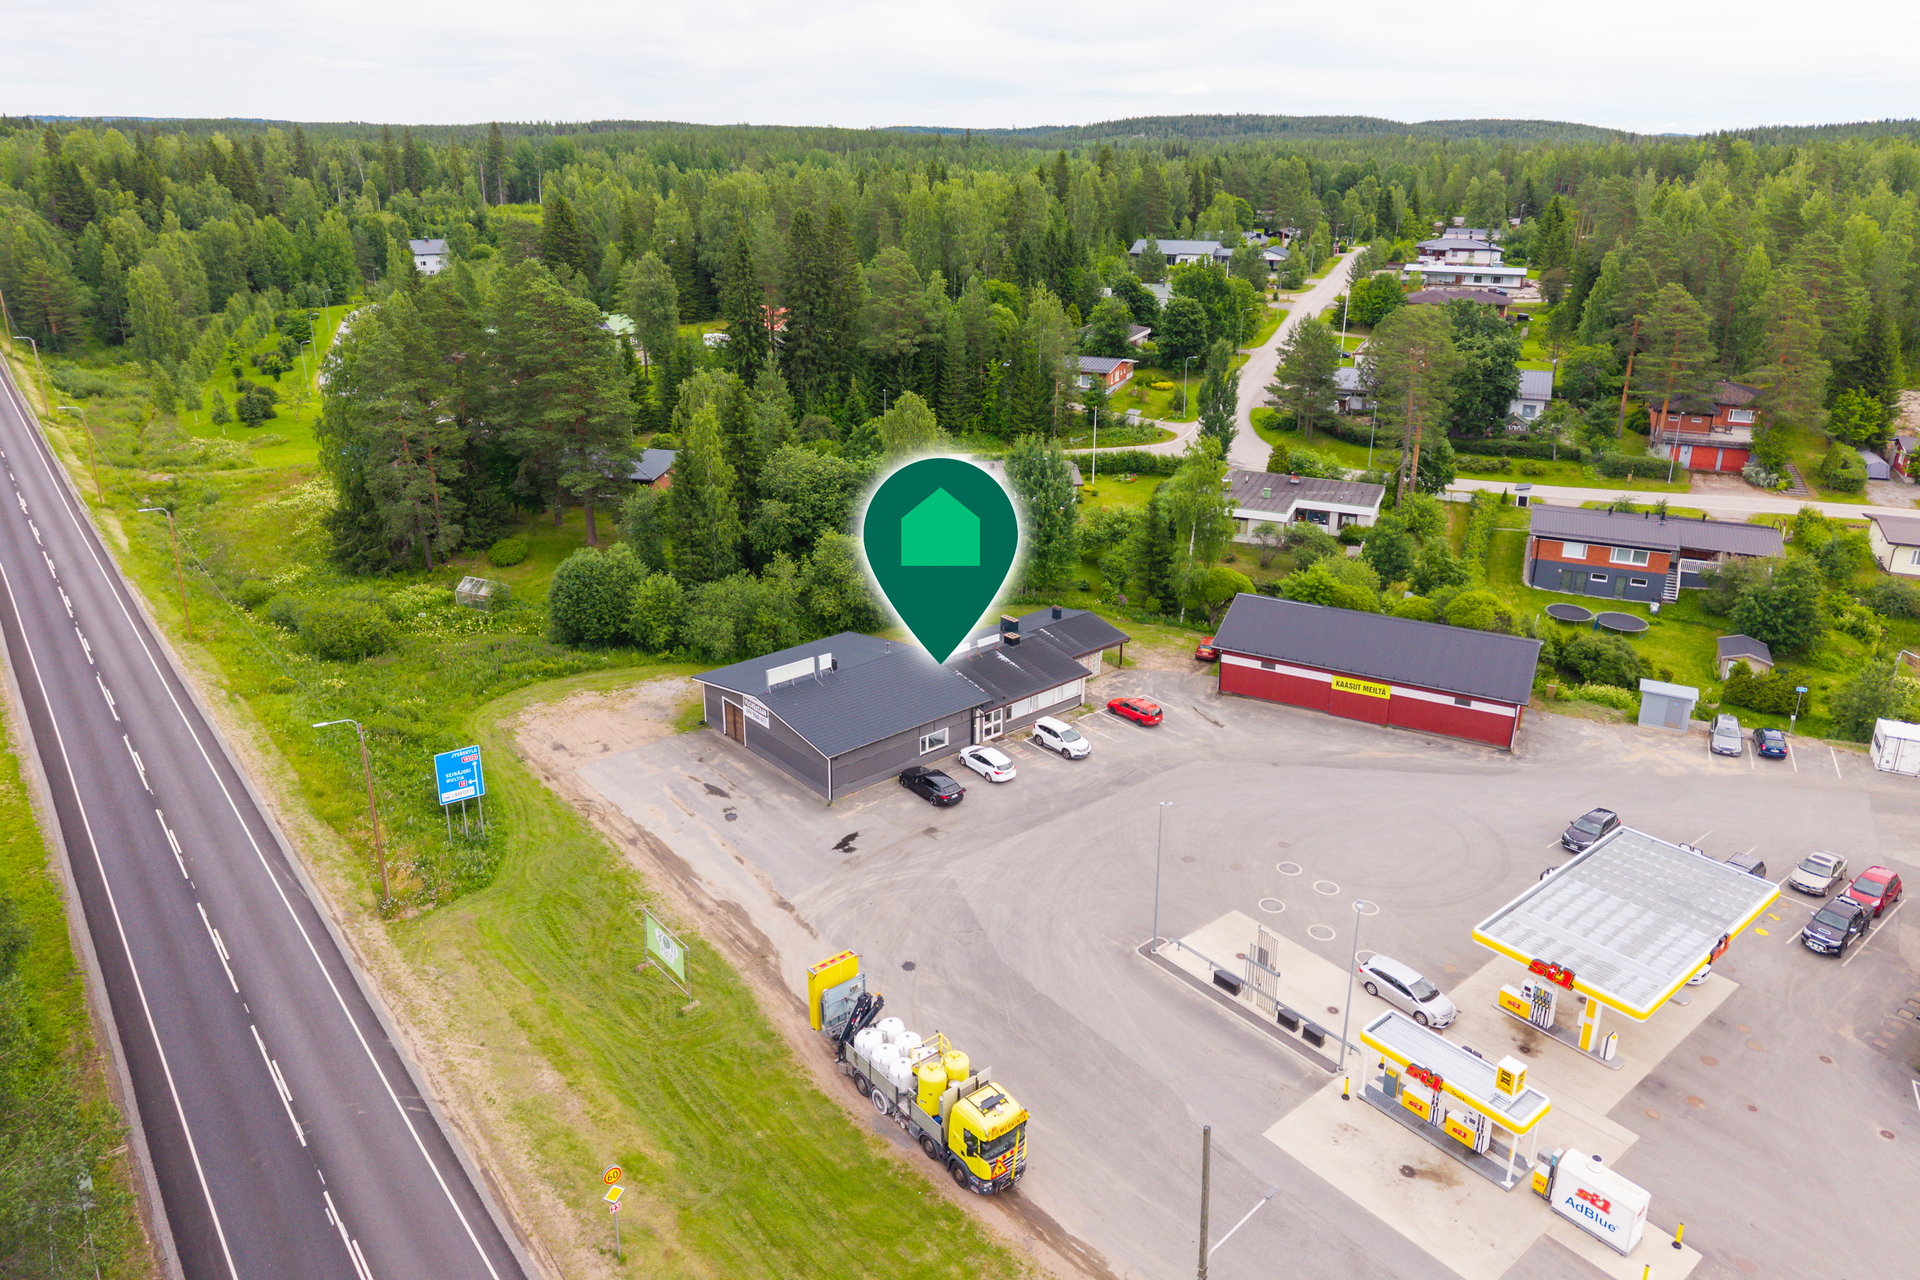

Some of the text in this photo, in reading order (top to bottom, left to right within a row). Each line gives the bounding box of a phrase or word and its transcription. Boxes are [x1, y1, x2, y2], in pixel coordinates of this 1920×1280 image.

[1335, 680, 1361, 691] KAASUT
[1451, 1089, 1466, 1102] Truck
[607, 1170, 619, 1182] 60
